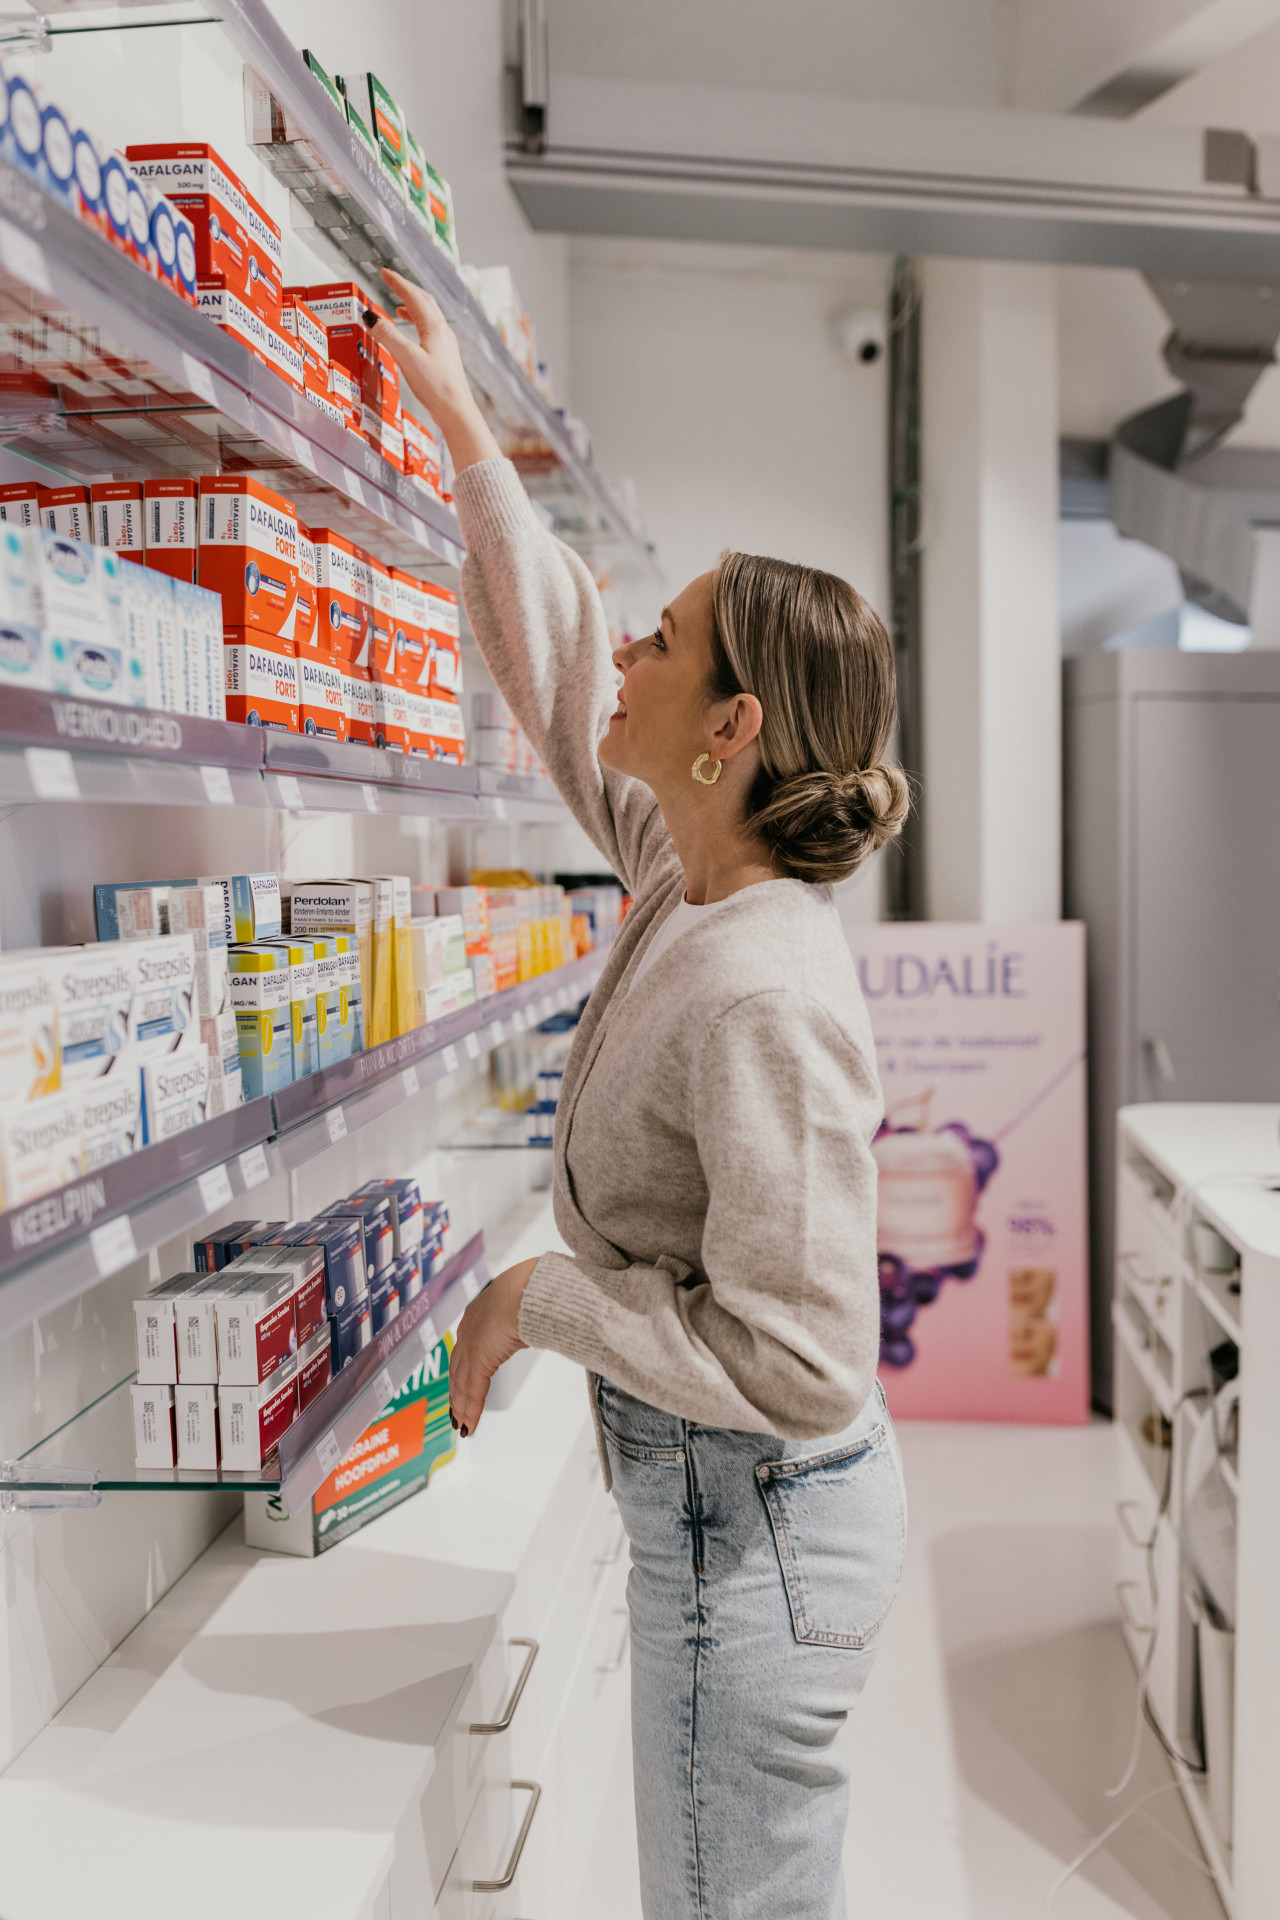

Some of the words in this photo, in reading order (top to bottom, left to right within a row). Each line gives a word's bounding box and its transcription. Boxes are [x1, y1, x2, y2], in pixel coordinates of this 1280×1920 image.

[129, 164, 204, 177] DAFALGAN
[210, 166, 248, 219] DAFALGAN
[249, 212, 282, 260] DAFALGAN
[228, 297, 266, 341] DAFALGAN
[309, 301, 351, 312] DAFALGAN
[297, 310, 328, 351] DAFALGAN
[268, 332, 303, 374] DAFALGAN
[125, 503, 133, 546] DAFALGAN
[250, 504, 296, 542] DAFALGAN
[275, 536, 296, 560] FORTE
[331, 551, 366, 579] DAFALGAN
[249, 653, 295, 681] DAFALGAN
[303, 665, 341, 689] DAFALGAN
[275, 679, 296, 699] FORTE
[325, 689, 343, 706] FORTE
[343, 682, 372, 702] AFALGAN
[51, 702, 183, 750] VERKOUDHEID
[357, 702, 374, 718] FORTE
[294, 896, 346, 906] Perdolan
[137, 953, 192, 985] Strepsils
[858, 940, 1026, 999] UDALÍE
[156, 1063, 206, 1101] Strepsils
[83, 1089, 137, 1129] trepsils
[10, 1177, 106, 1250] KEELPIJN
[335, 1443, 400, 1491] HOOFDPIJN
